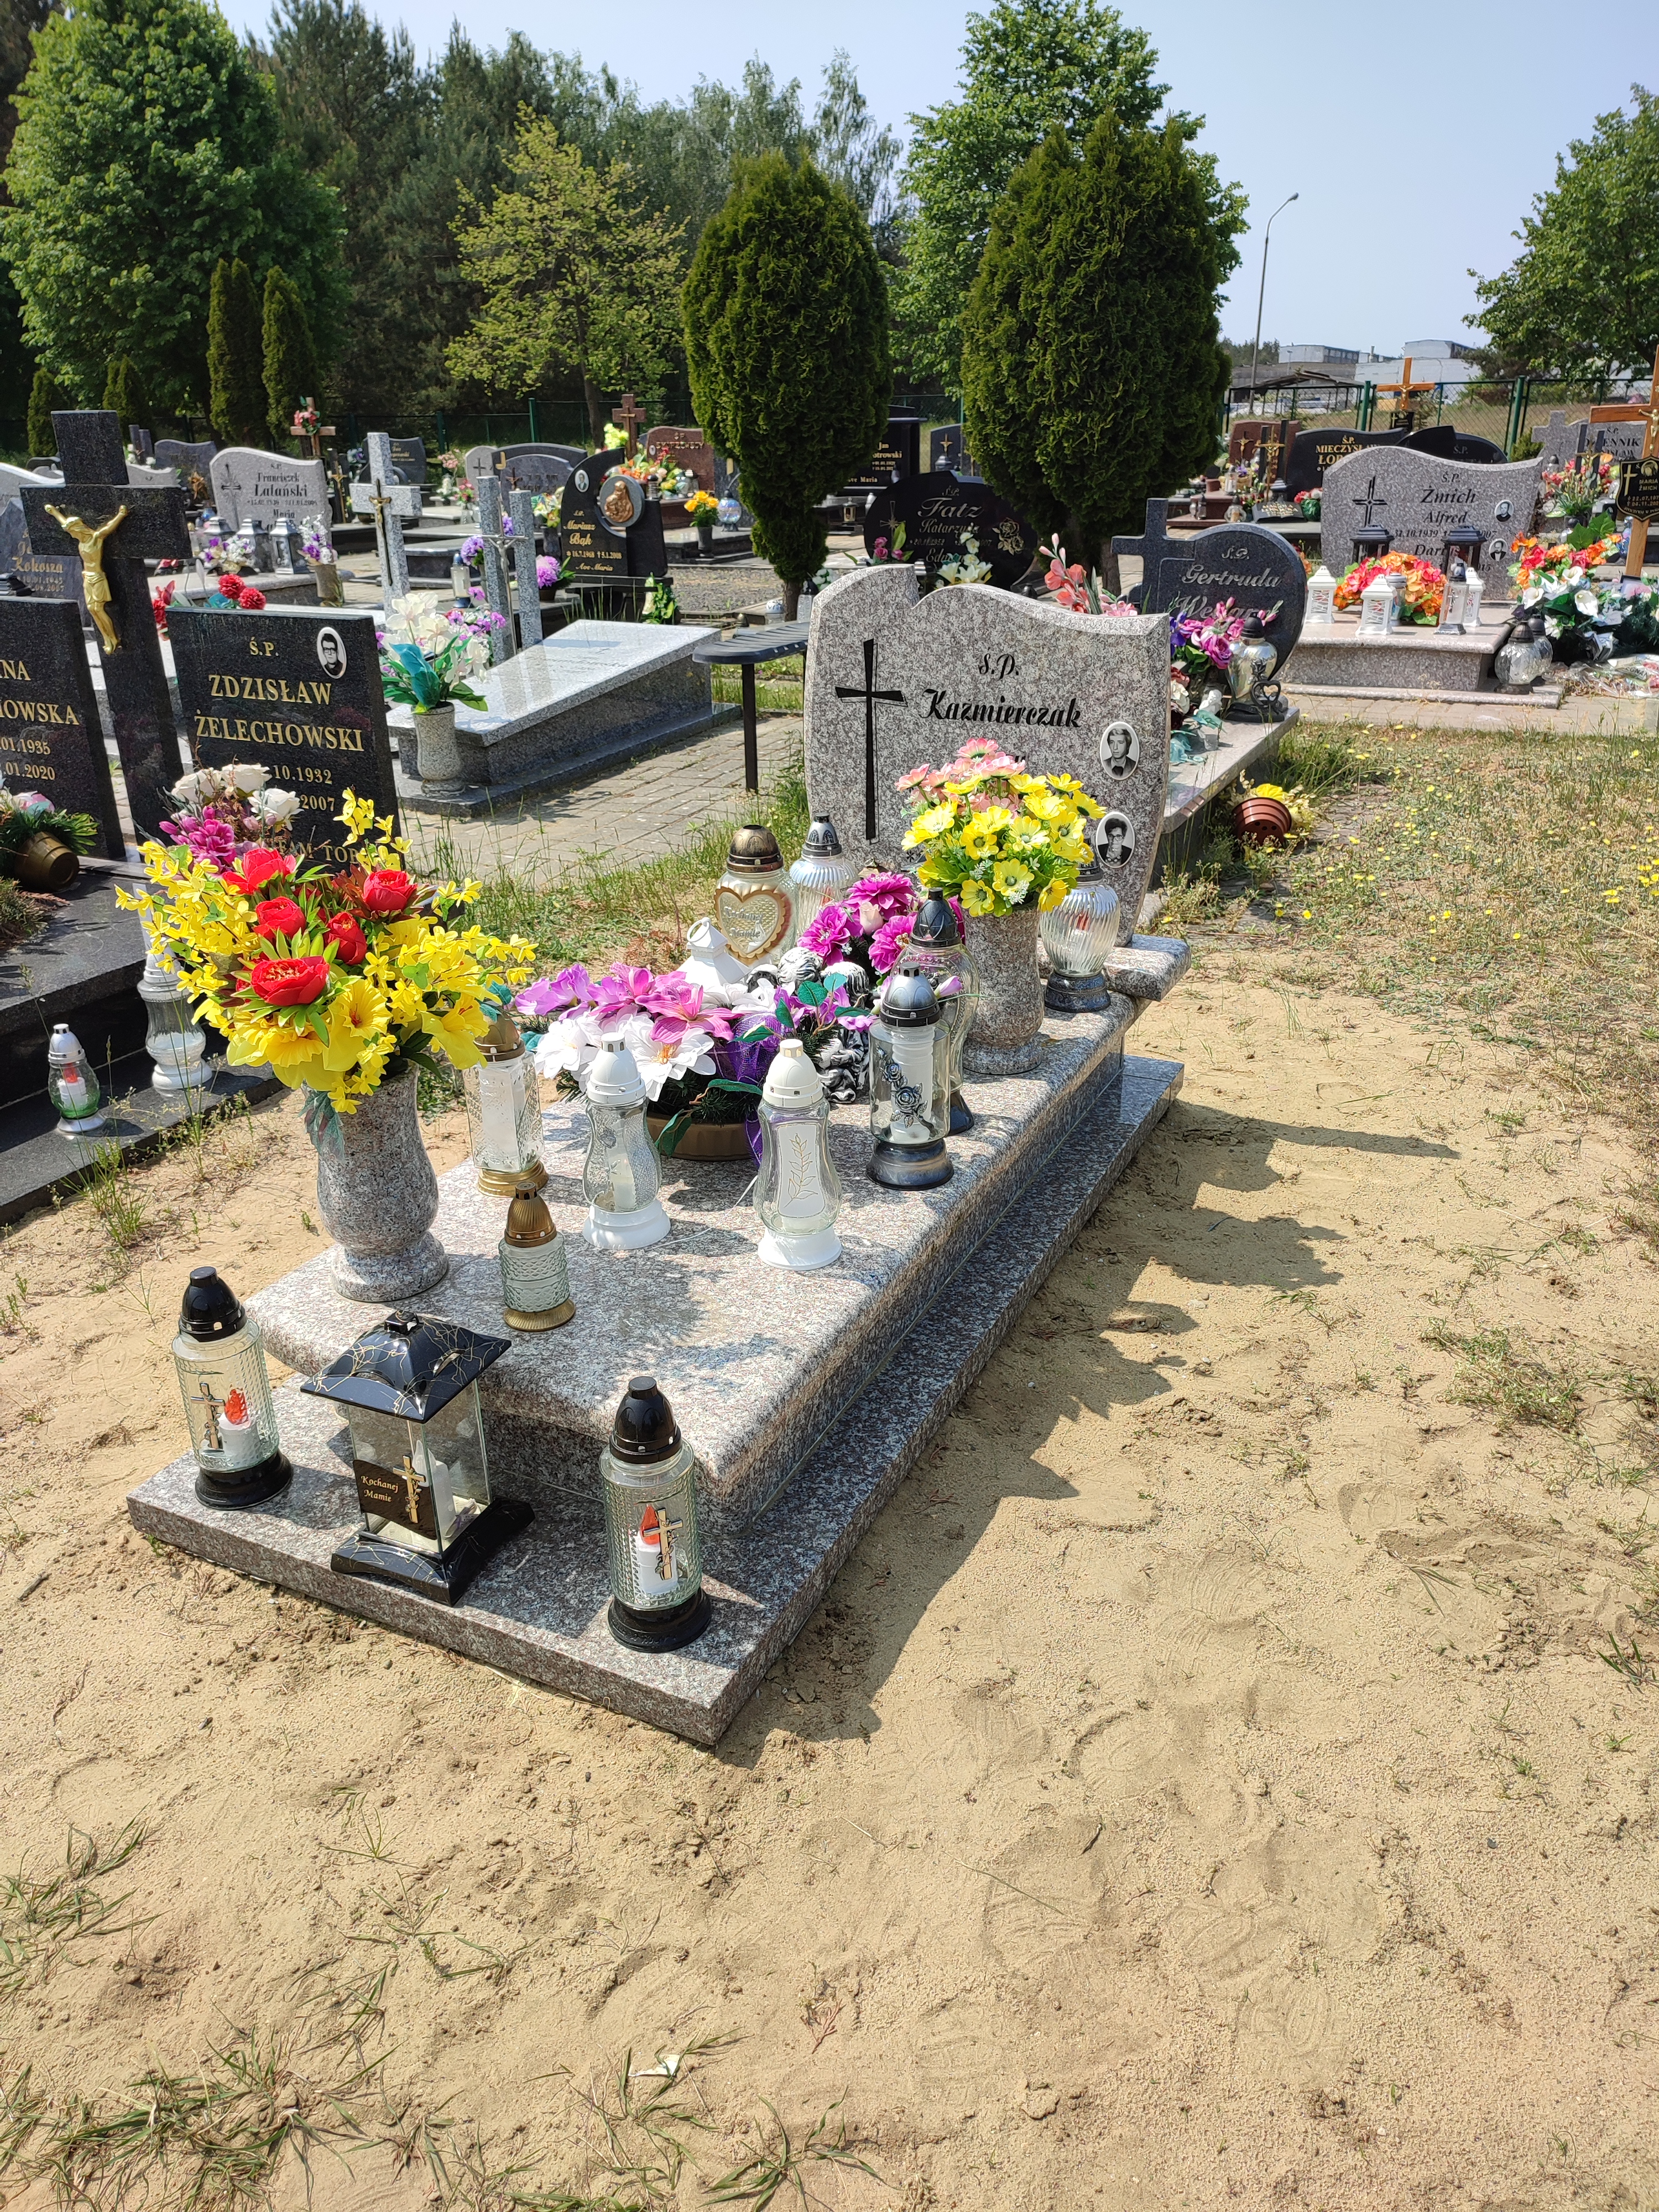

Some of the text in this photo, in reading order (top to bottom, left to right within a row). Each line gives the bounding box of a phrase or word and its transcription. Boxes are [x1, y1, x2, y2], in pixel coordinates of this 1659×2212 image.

[1420, 485, 1477, 504] Żmich
[563, 520, 597, 530] Mariusz
[1423, 510, 1468, 525] Alfred
[1181, 564, 1282, 588] Gertruda
[249, 637, 279, 656] Ś.P.
[0, 660, 32, 681] NA
[208, 674, 332, 706] ZDZISŁAW
[0, 699, 80, 726] OWSKA
[919, 689, 1082, 728] Kaźmierczak
[194, 708, 364, 752] ŻELECHOWSKI
[0, 737, 51, 755] 01.1935
[3, 761, 56, 781] .01.2020
[273, 765, 333, 785] 10.1932
[300, 794, 335, 812] 2007
[361, 1475, 399, 1493] Kochanej
[363, 1489, 392, 1503] Mamie
